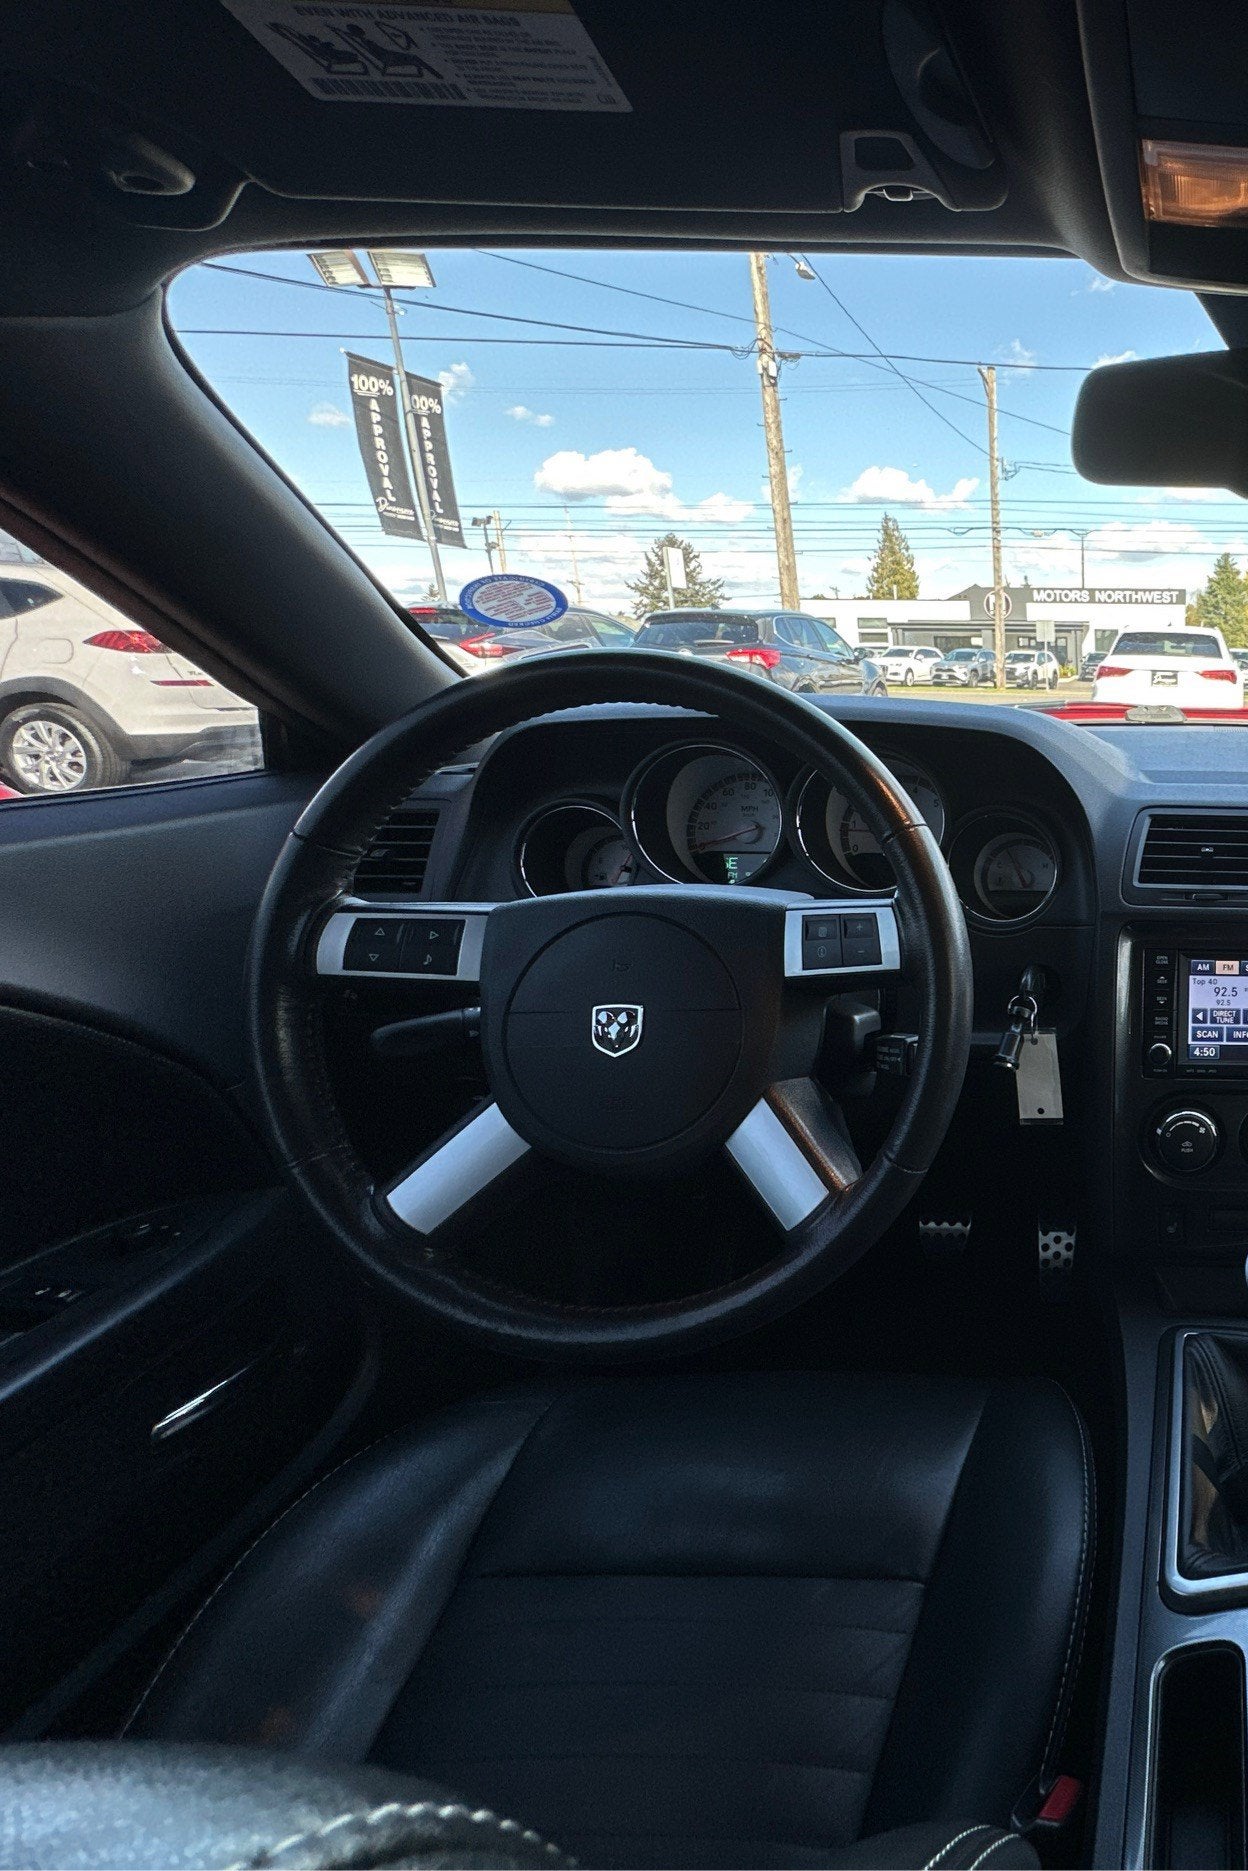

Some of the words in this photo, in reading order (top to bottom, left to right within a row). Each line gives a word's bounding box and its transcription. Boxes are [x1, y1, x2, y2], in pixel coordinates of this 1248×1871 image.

[376, 9, 455, 23] ADVANCED
[457, 14, 481, 23] AIR
[350, 373, 394, 397] 100%
[410, 393, 442, 415] 00%
[368, 397, 397, 503] APPROVAL
[420, 415, 444, 515] APPROVAL
[1032, 589, 1090, 603] MOTORS
[1095, 590, 1180, 604] NORTHWEST
[744, 782, 757, 791] 80
[722, 788, 735, 797] 60
[704, 802, 718, 811] 40
[740, 805, 760, 813] MPH
[697, 821, 710, 831] 20
[1196, 963, 1210, 971] AM
[1222, 963, 1234, 971] FM
[1193, 977, 1206, 986] Top
[1213, 986, 1238, 997] 92.5
[1212, 1010, 1237, 1018] DIRECT
[1216, 1016, 1235, 1024] TUNE
[1196, 1030, 1219, 1039] SCAN
[1193, 1047, 1216, 1057] 4:50
